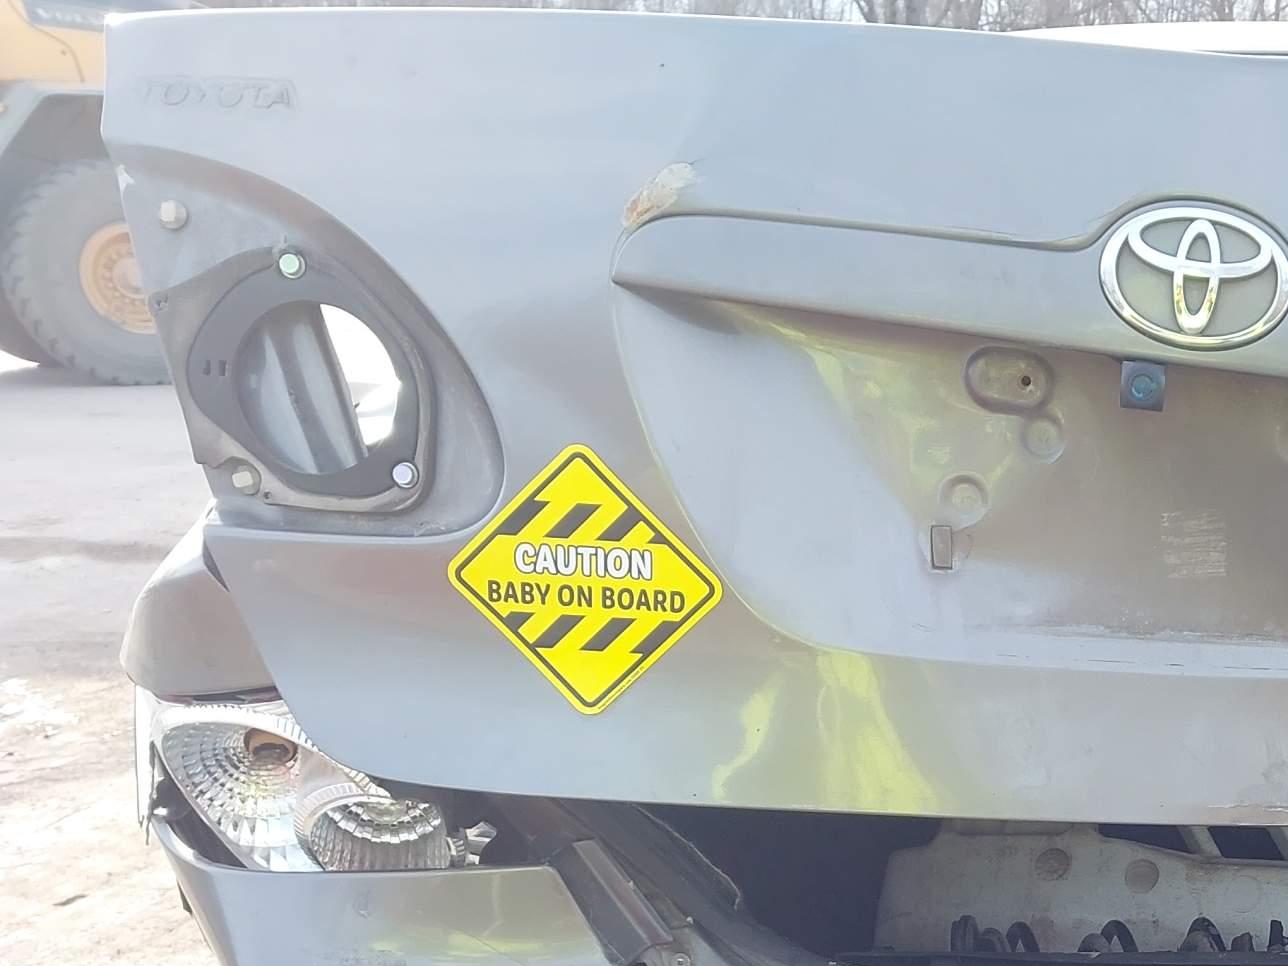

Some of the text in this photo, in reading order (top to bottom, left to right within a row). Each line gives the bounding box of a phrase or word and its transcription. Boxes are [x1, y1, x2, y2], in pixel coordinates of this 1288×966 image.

[514, 541, 653, 581] CAUTION
[487, 579, 686, 614] BABY ON BOARD
